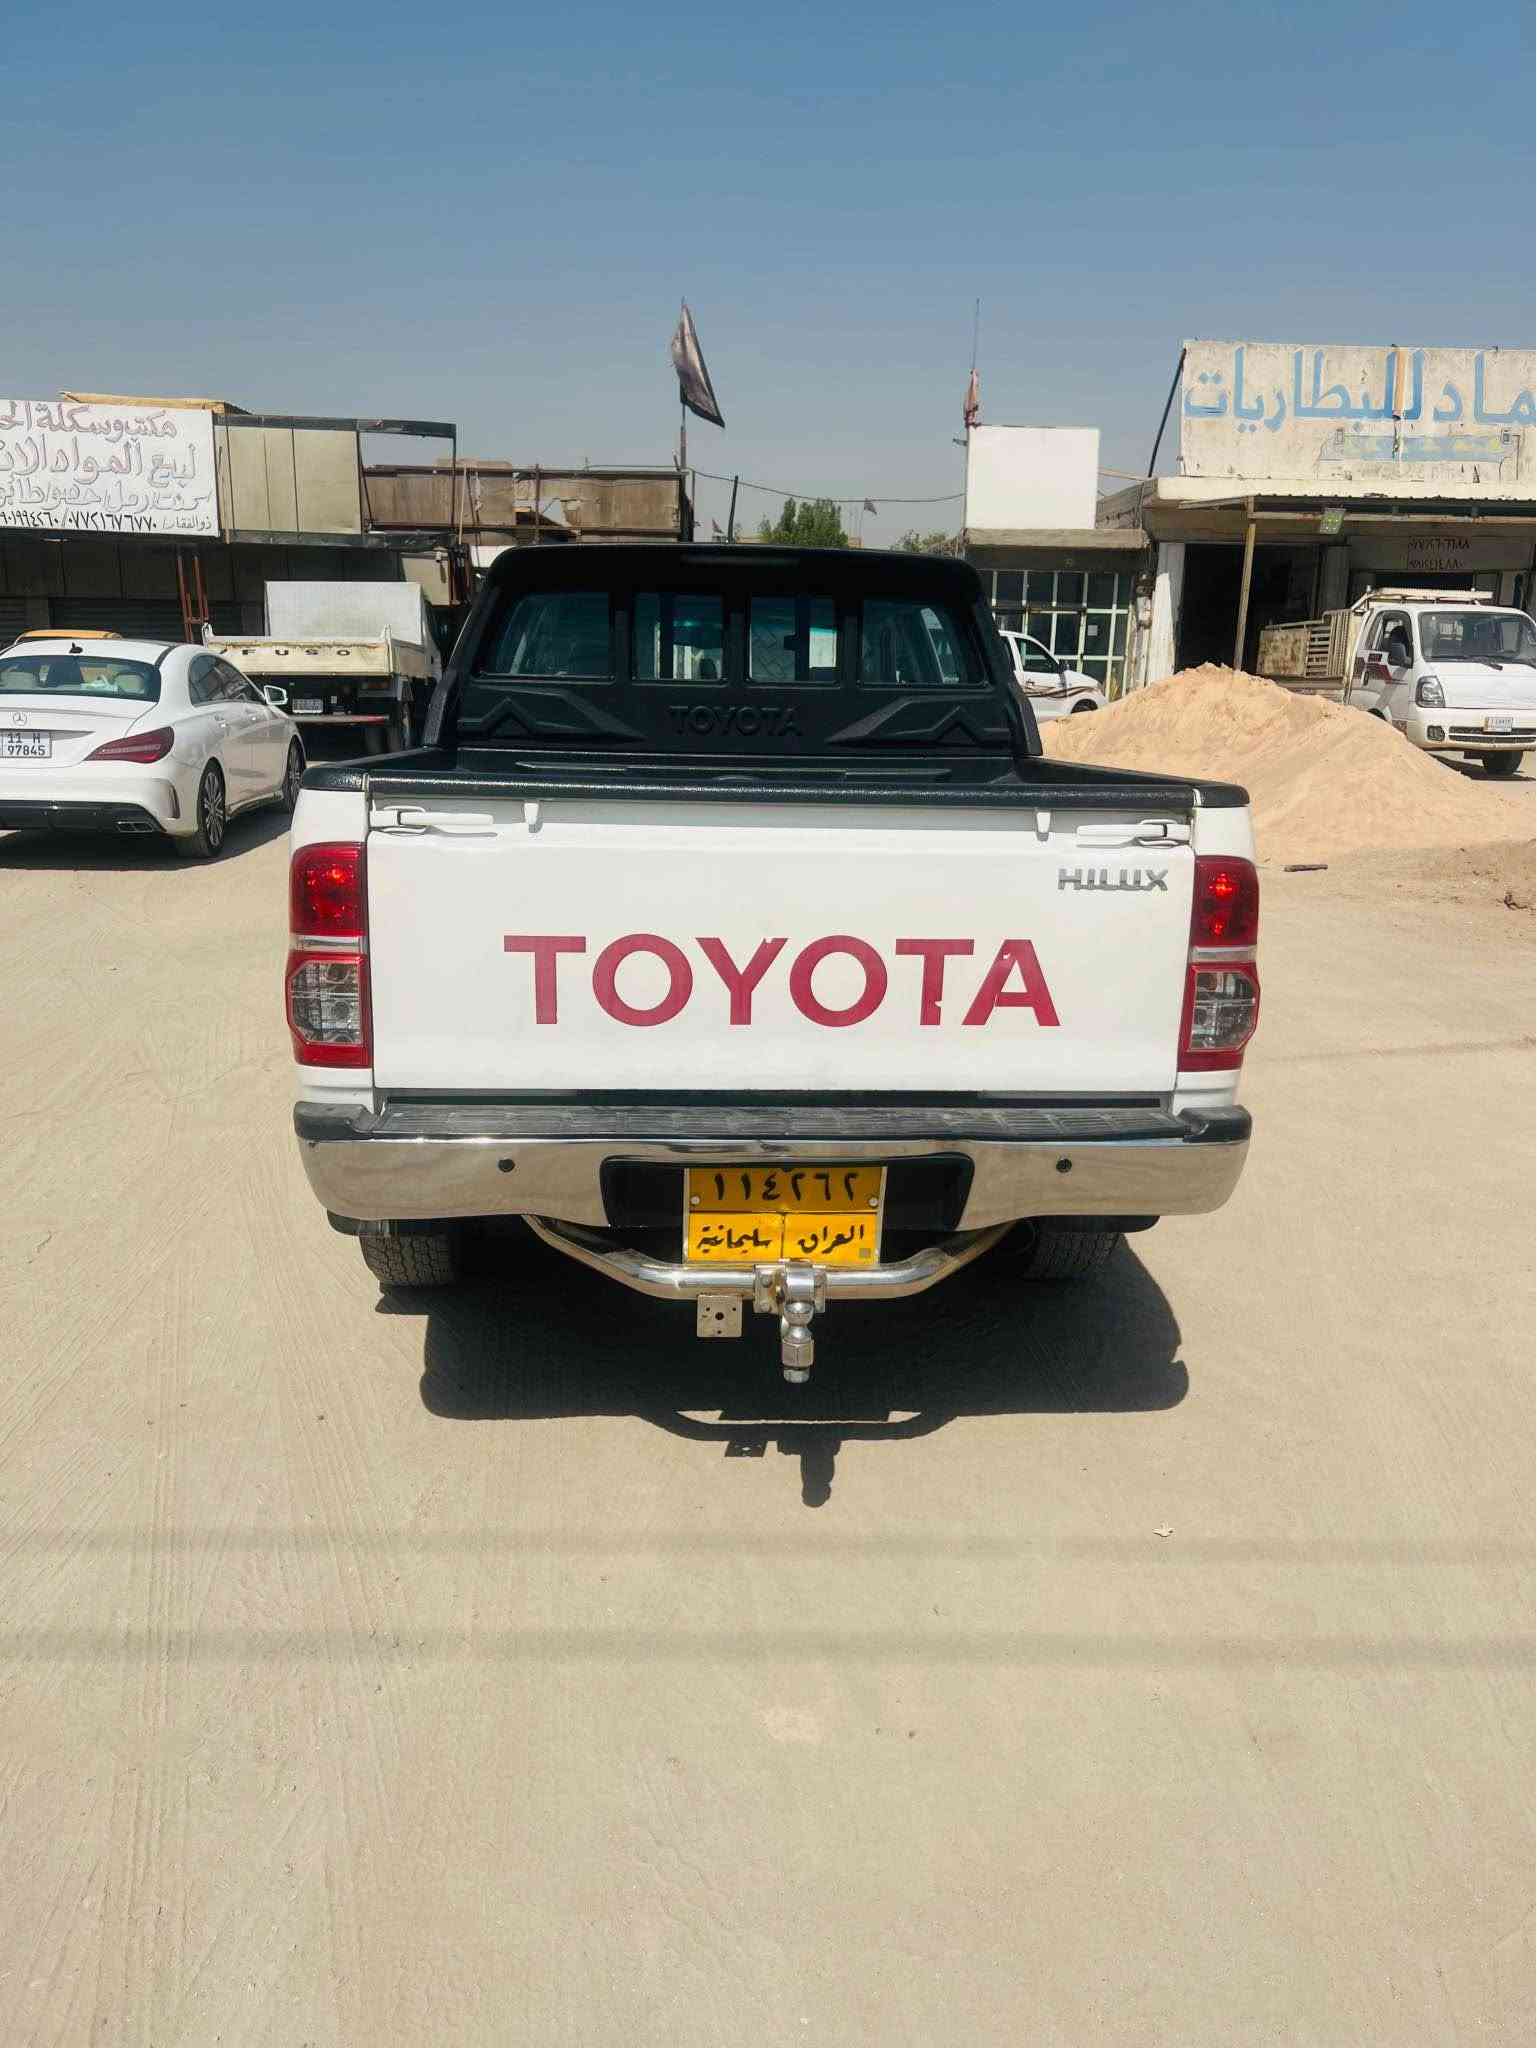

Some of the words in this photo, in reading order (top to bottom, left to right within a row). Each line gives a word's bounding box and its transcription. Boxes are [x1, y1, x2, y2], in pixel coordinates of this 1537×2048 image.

[1183, 347, 1425, 432] للبطاريات
[241, 648, 351, 656] FUSO
[669, 704, 803, 737] TOYOTA
[7, 744, 46, 756] 97845
[1057, 868, 1168, 891] HILUX
[504, 933, 1060, 1026] TOYOTA
[714, 1171, 859, 1201] ١١٤٢٦٢
[697, 1224, 773, 1254] سليمانية
[797, 1224, 865, 1254] العراق
